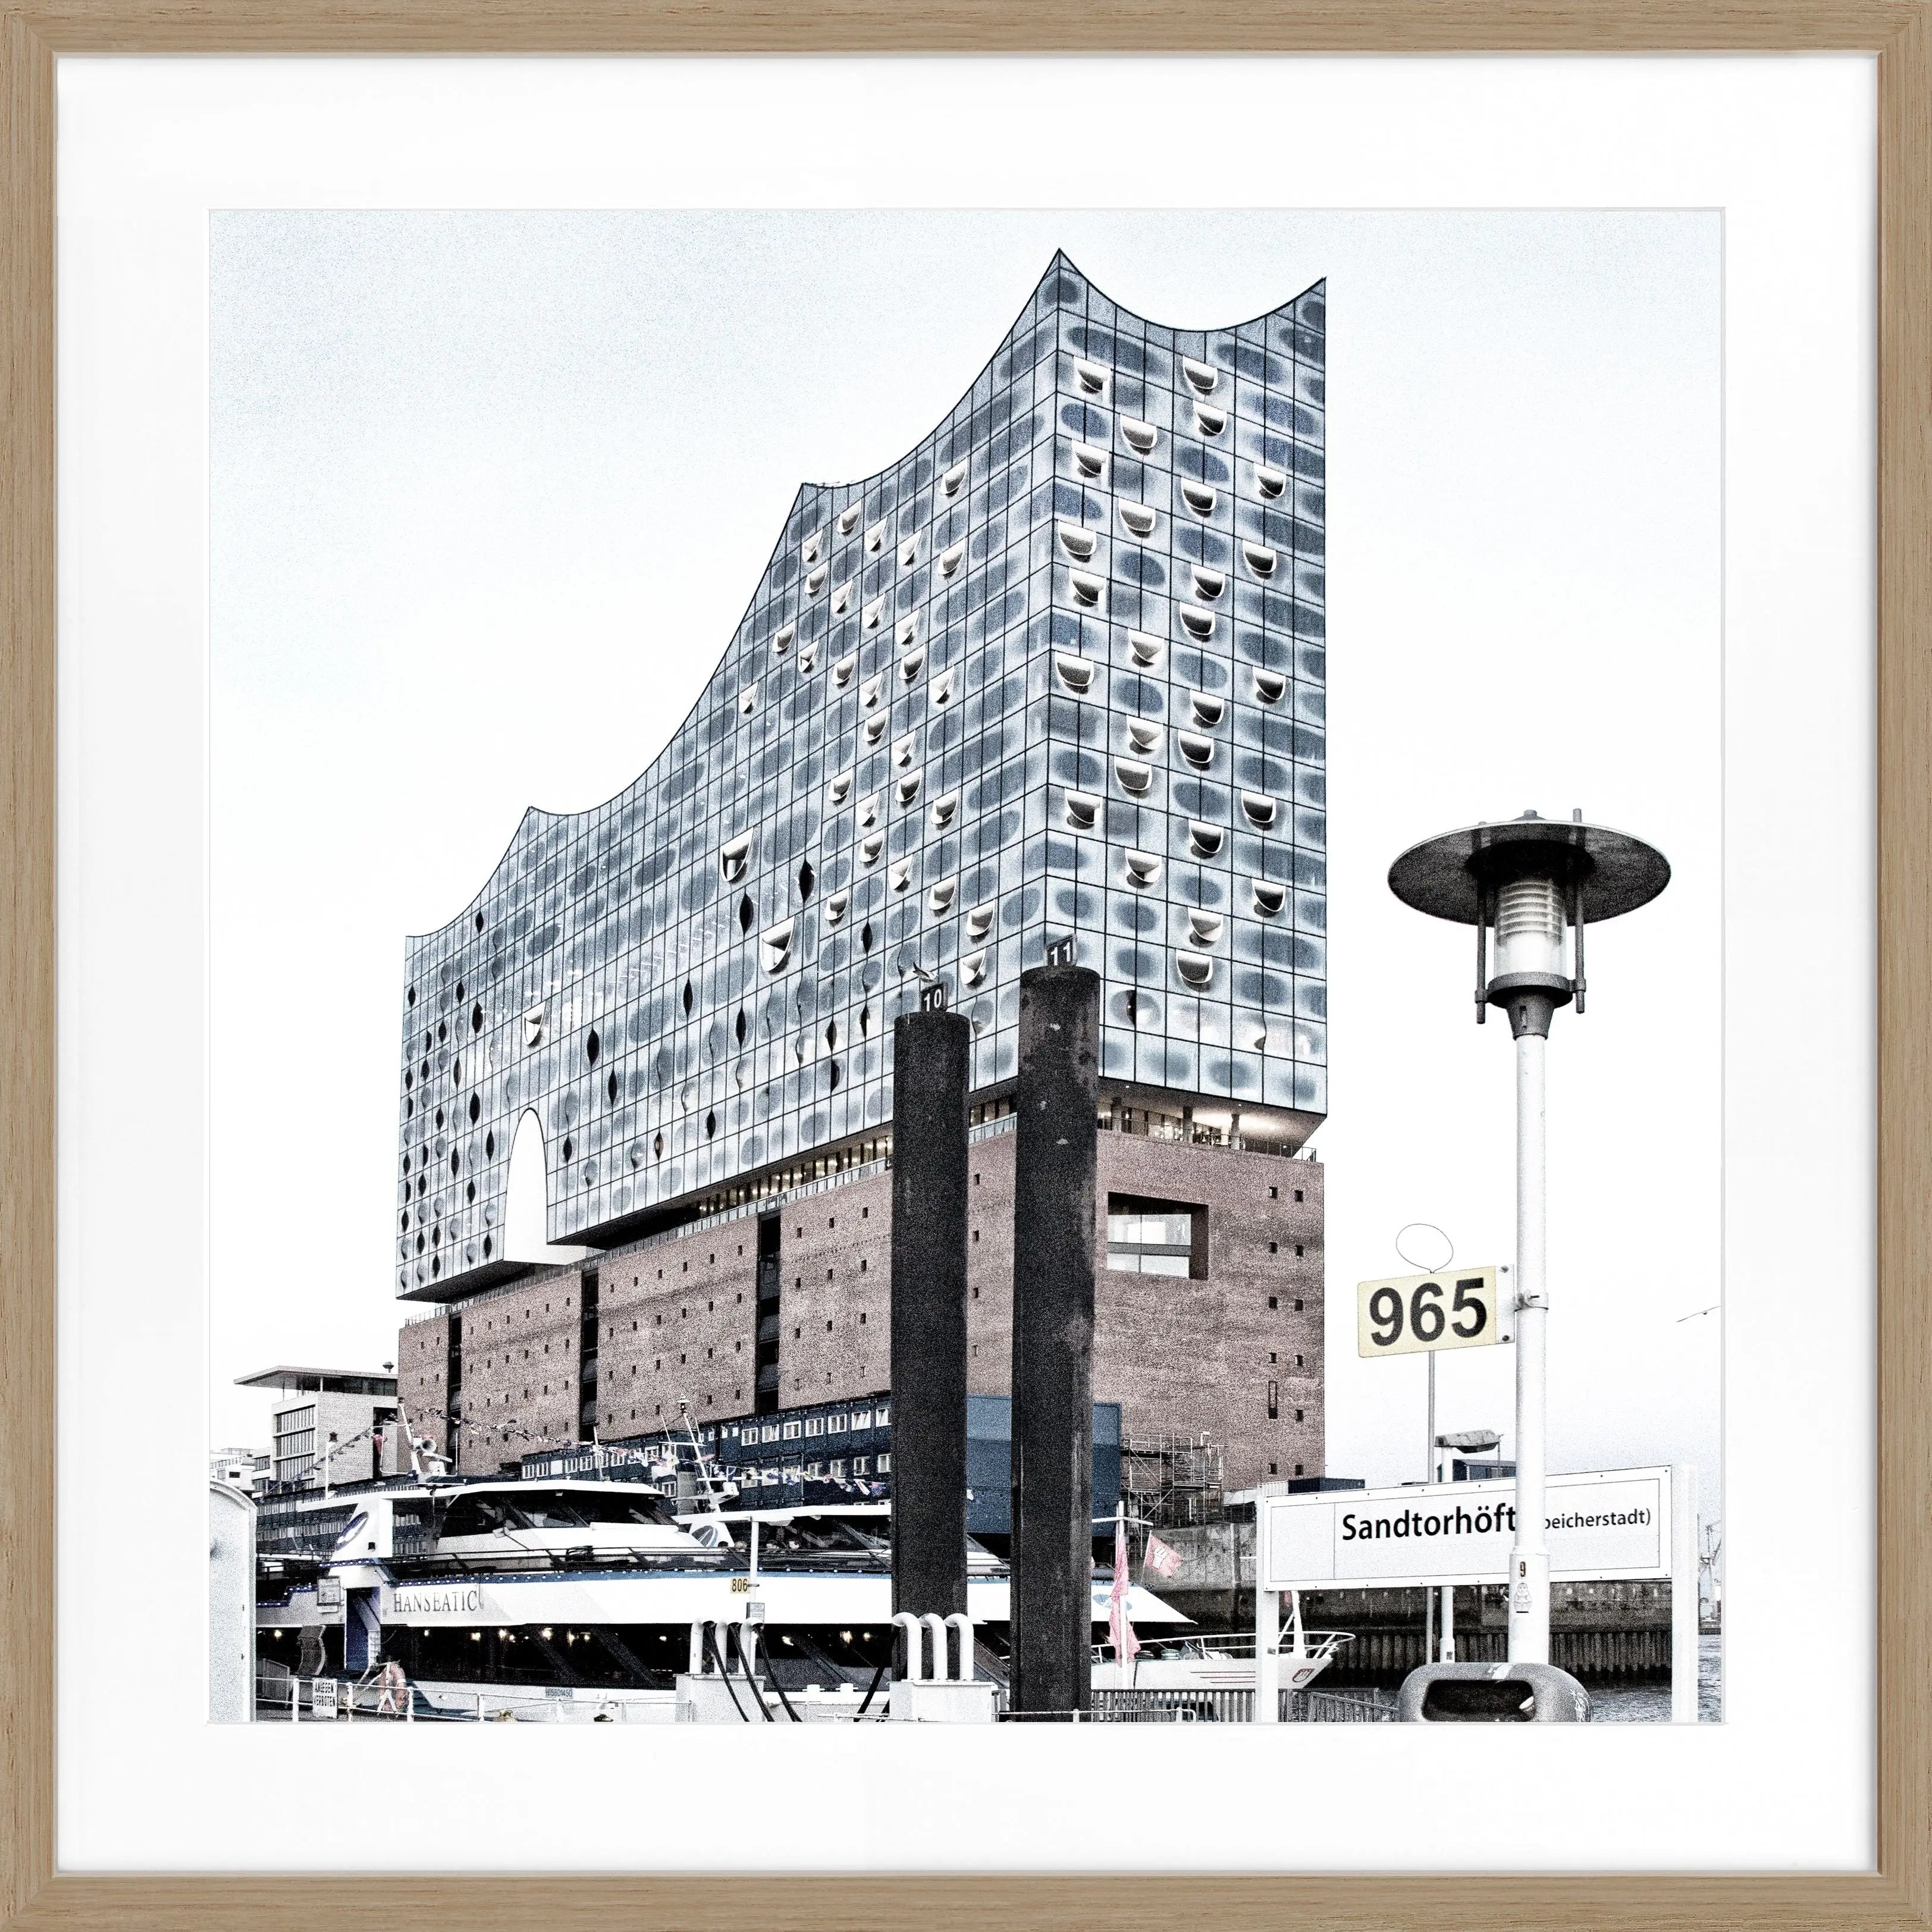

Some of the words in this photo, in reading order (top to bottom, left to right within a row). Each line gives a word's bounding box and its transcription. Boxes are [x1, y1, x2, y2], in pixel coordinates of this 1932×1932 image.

[1050, 942, 1071, 966] 11
[924, 989, 942, 1012] 10
[1369, 1277, 1487, 1346] 965
[1342, 1502, 1516, 1541] Sandtorhöft
[1545, 1508, 1651, 1529] eicherstadt)
[1520, 1561, 1526, 1577] 9
[732, 1578, 748, 1592] 806
[393, 1590, 476, 1613] HANSEATIC
